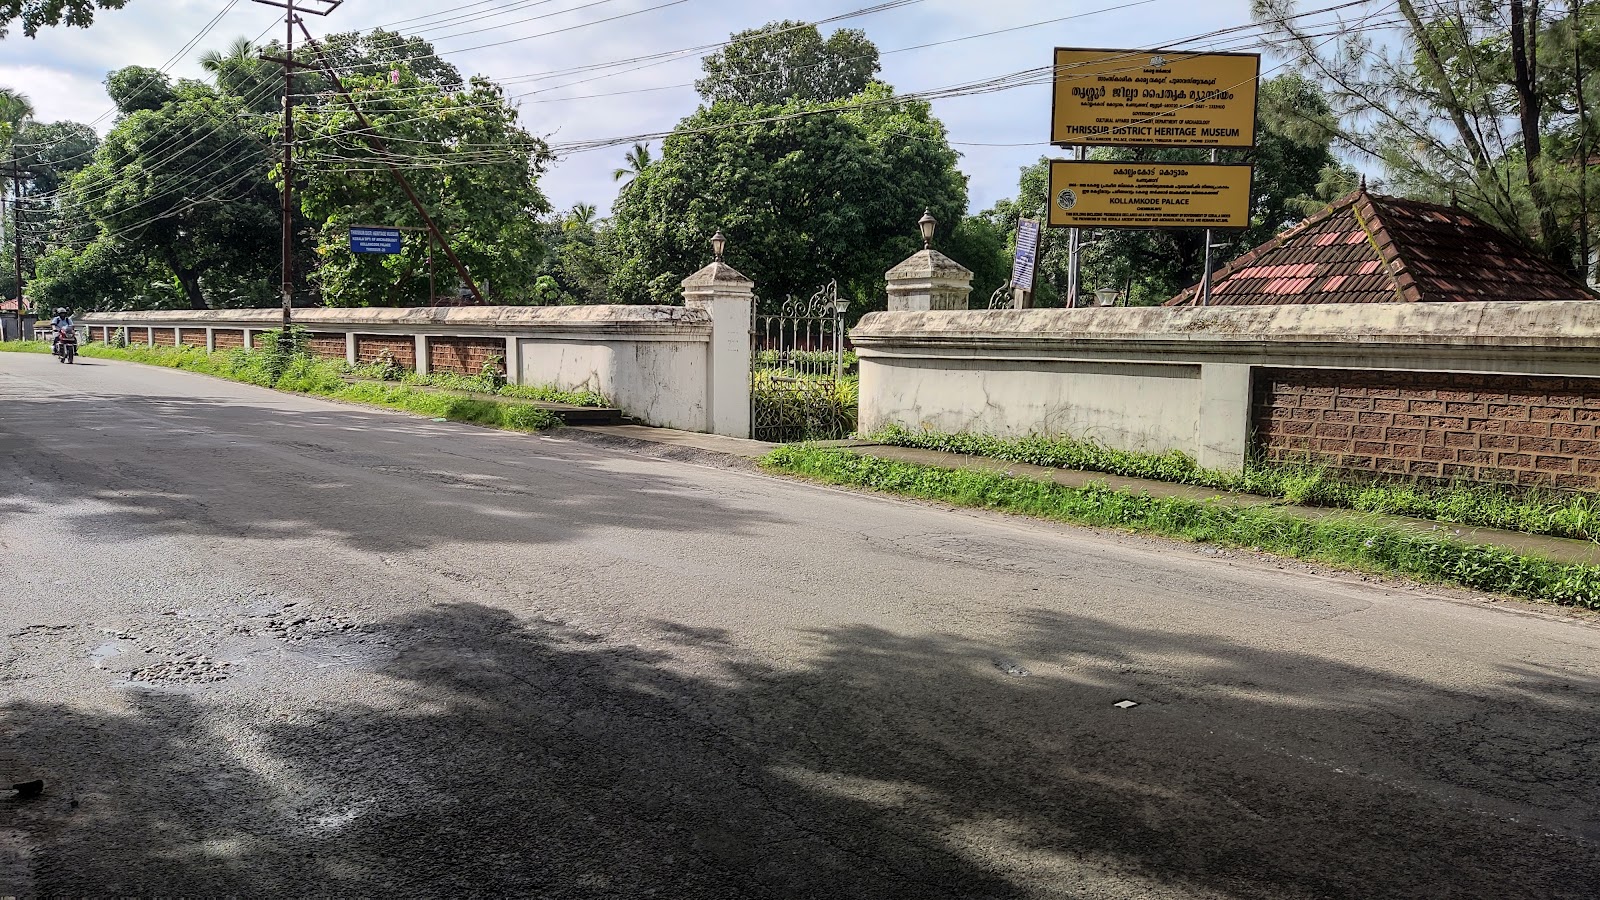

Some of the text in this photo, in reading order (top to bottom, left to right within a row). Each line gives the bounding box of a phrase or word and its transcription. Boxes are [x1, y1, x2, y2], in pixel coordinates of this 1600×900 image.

[1112, 86, 1139, 101] ജില്ലാ
[1142, 87, 1187, 101] പൈതൃക
[1066, 125, 1240, 137] THRISSUR DISTRICT HERITAGE MUSEUM
